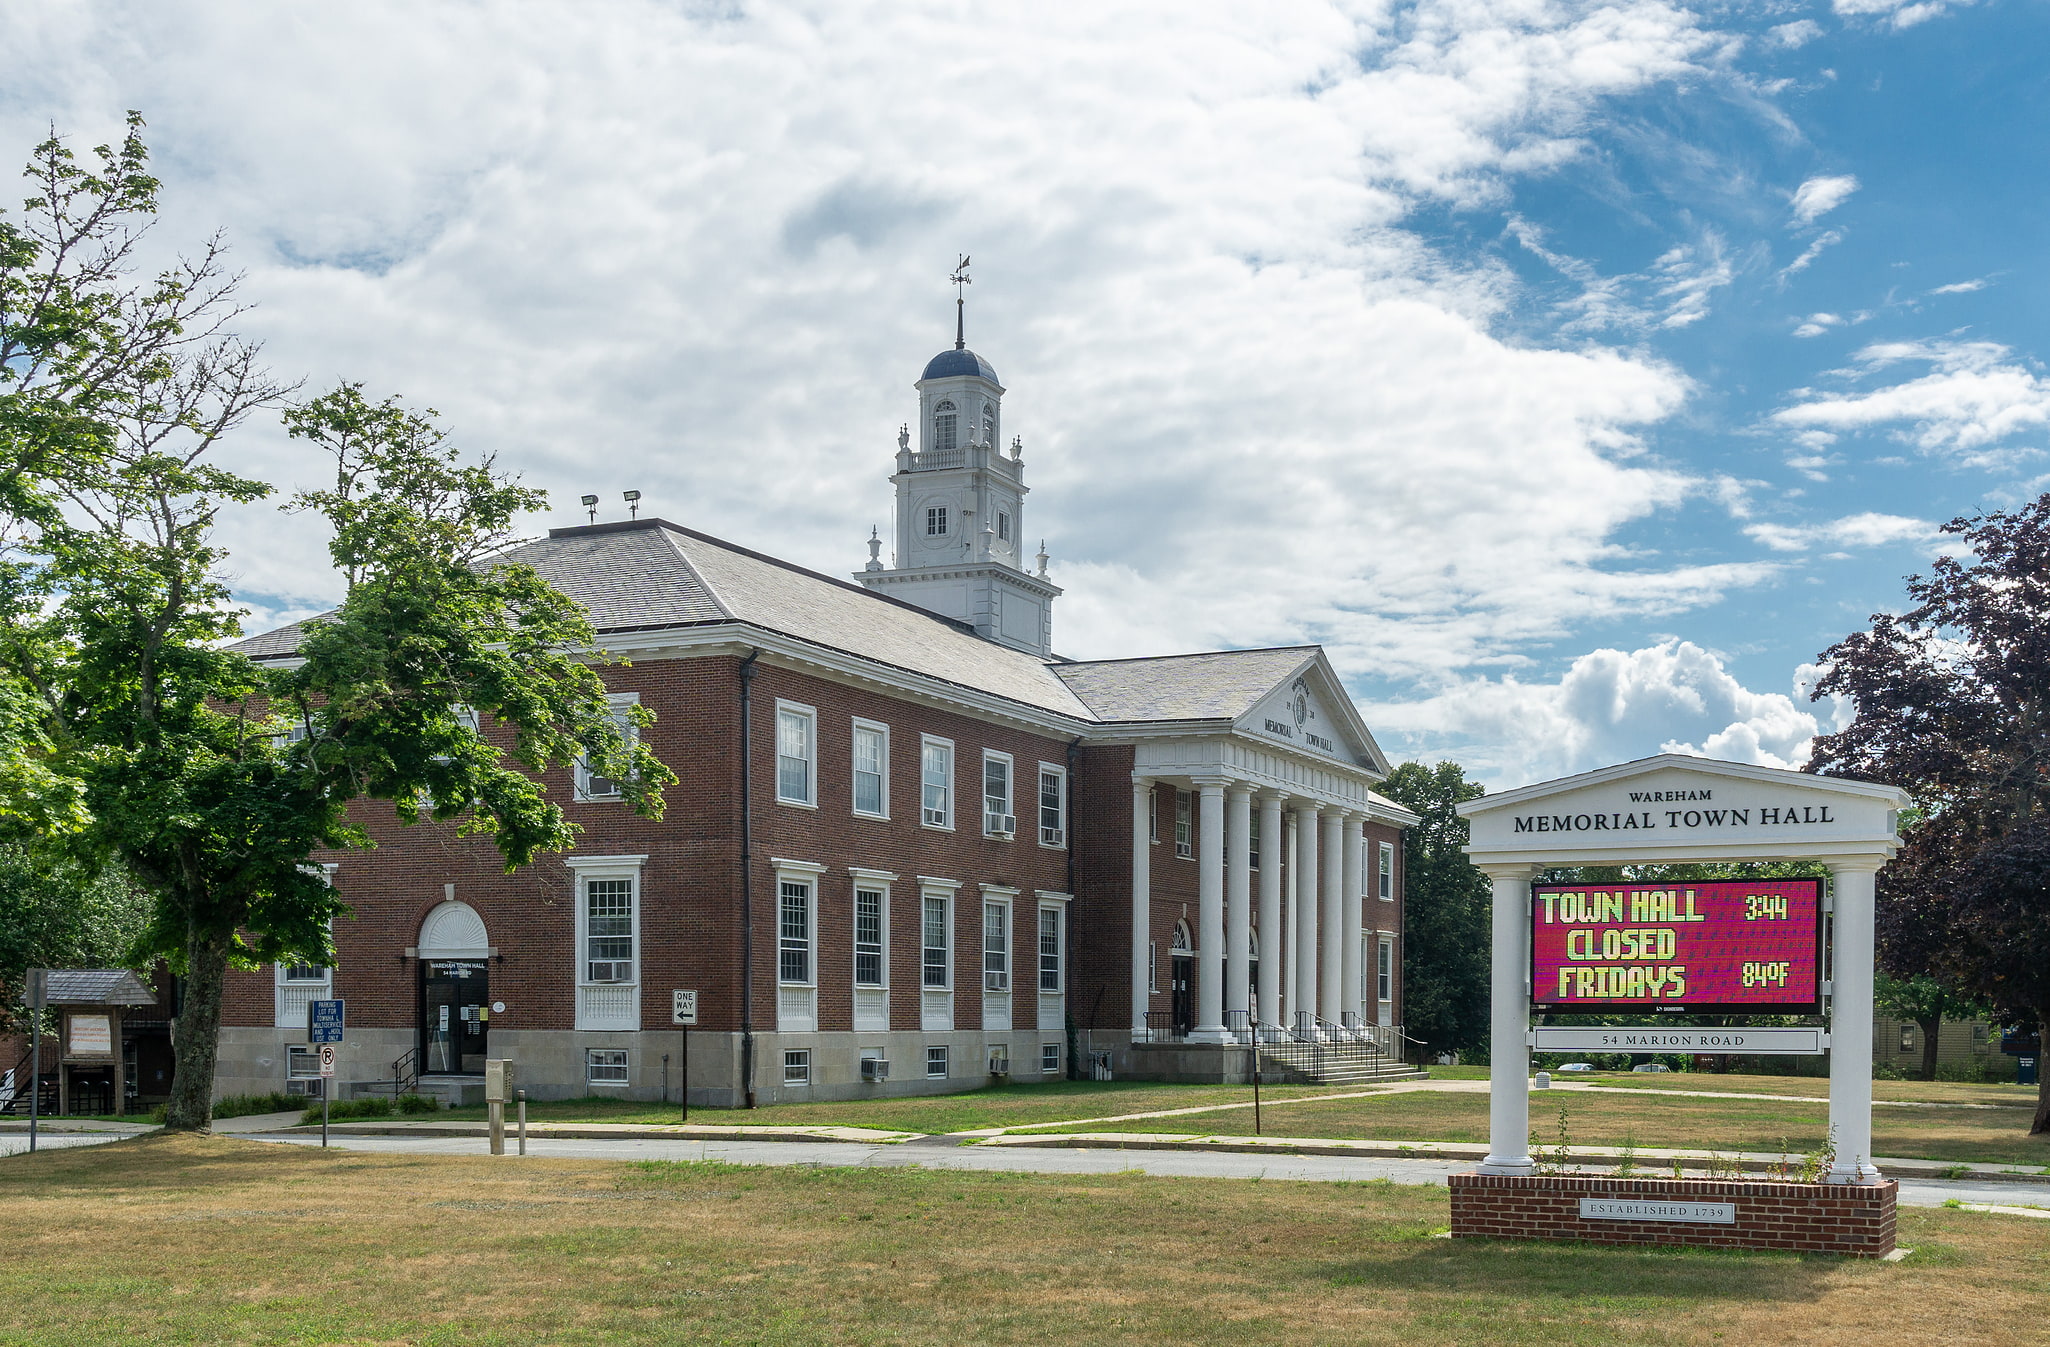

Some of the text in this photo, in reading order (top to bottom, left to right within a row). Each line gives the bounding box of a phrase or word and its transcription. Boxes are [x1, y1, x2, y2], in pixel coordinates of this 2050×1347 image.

[1264, 718, 1334, 753] MEMORIAL TOWN HALL
[1628, 789, 1713, 803] WAREHAM
[1513, 806, 1835, 833] MEMORIAL TOWN HALL
[1538, 890, 1705, 924] TOWN HALL
[1745, 895, 1788, 921] 3:44
[1567, 928, 1677, 961] CLOSED
[1558, 966, 1687, 999] FRIDAYS
[676, 1001, 693, 1009] WAY
[677, 992, 693, 1000] ONE
[1602, 1035, 1744, 1046] 54 MARION ROAD
[1590, 1204, 1724, 1217] ESTABLISHED 1739
